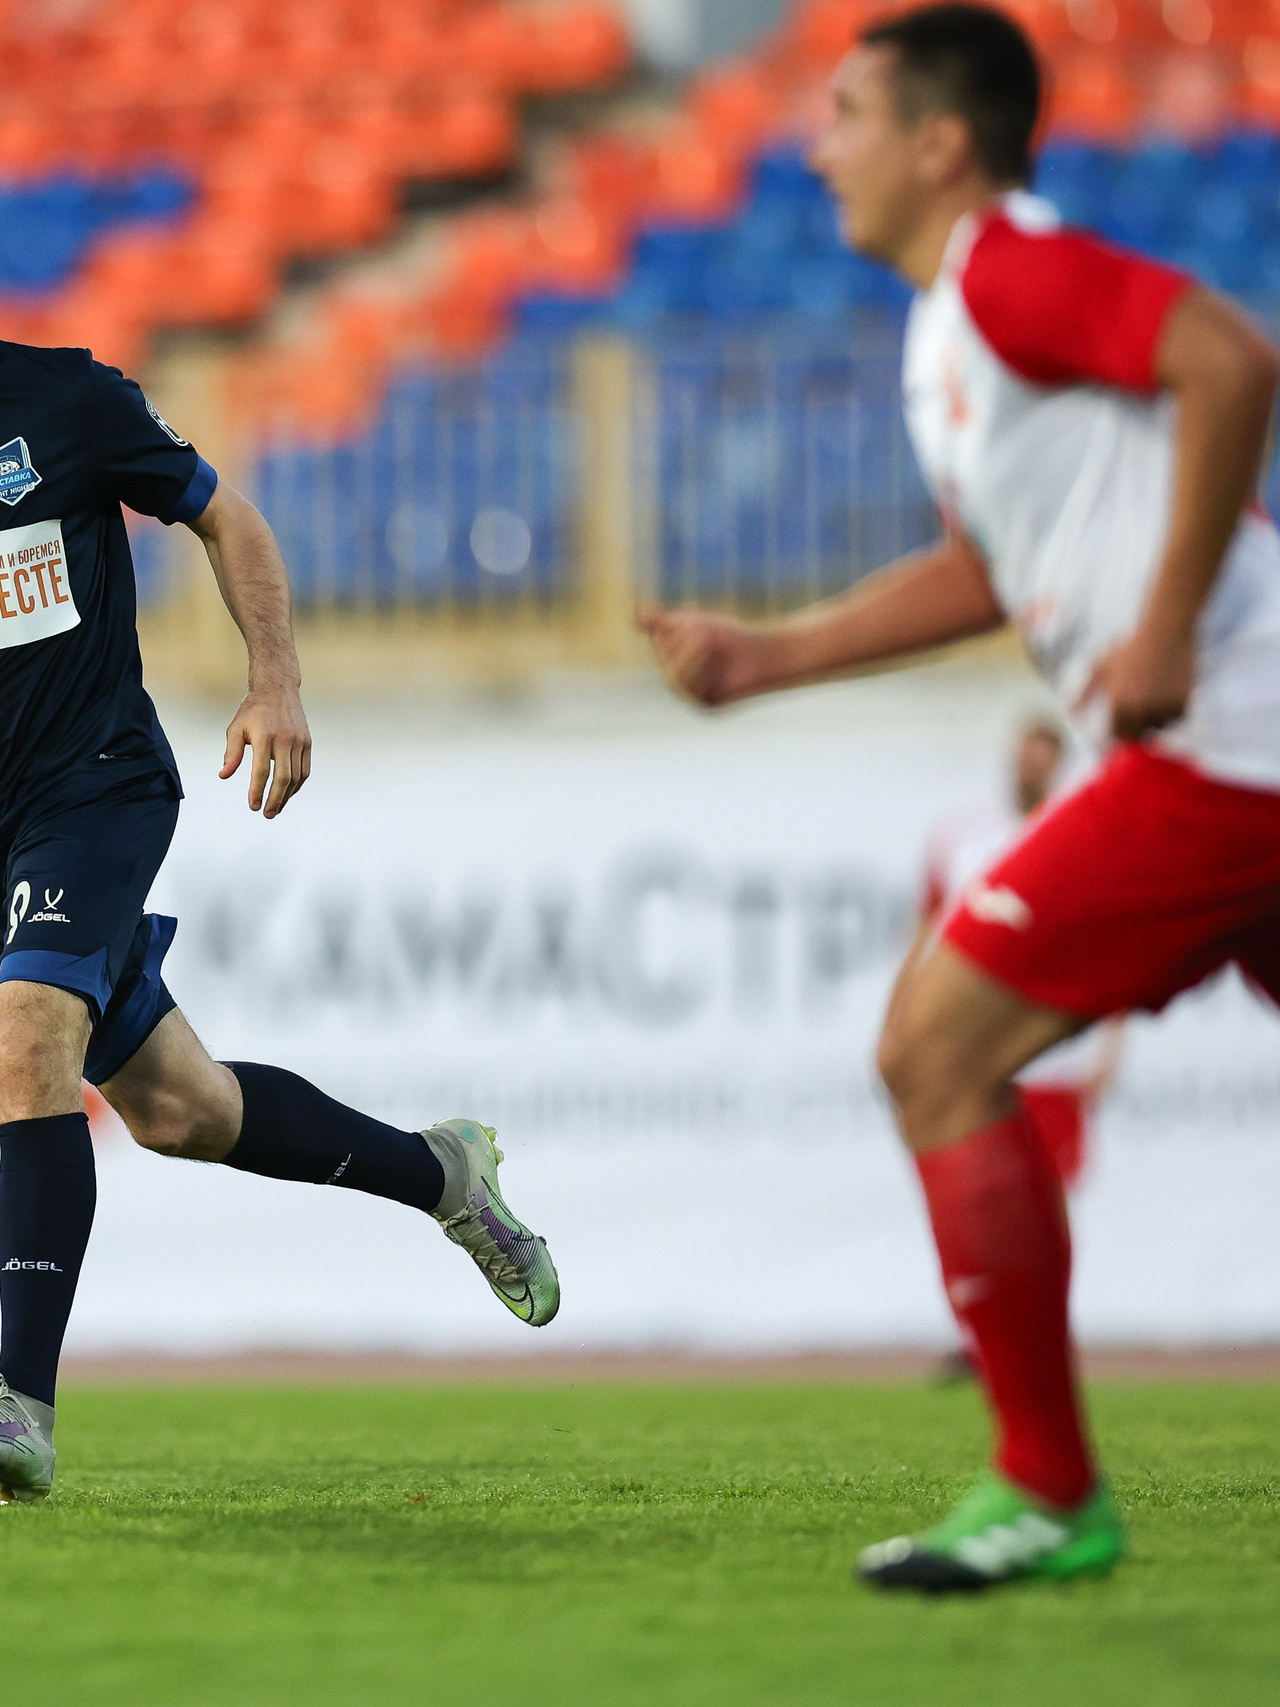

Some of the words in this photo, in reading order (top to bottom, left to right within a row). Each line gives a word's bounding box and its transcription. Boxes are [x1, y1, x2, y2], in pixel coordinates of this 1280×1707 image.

[7, 552, 16, 568] И
[17, 539, 61, 565] БОРЕМСЯ
[27, 911, 71, 923] JÖGEL
[1, 1257, 63, 1272] JÖGEL
